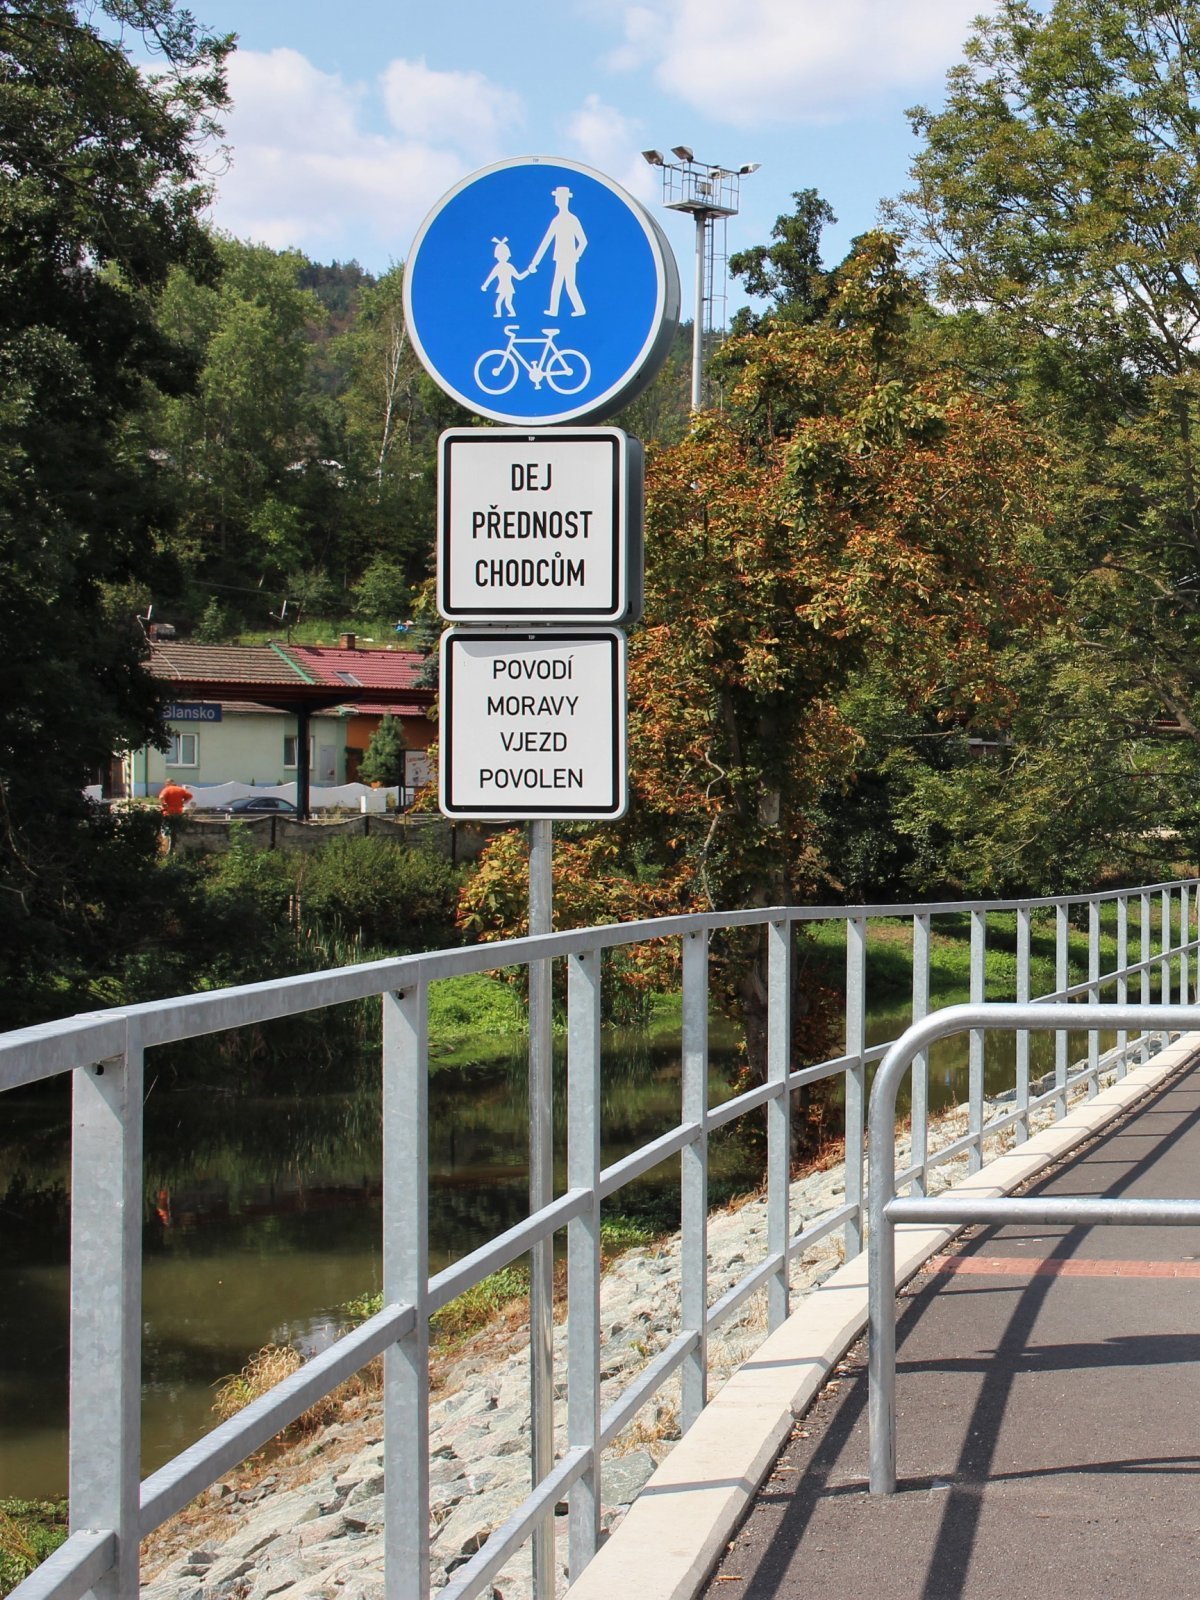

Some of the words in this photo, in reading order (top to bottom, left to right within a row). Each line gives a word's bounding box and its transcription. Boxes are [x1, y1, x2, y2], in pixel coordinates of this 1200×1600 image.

[511, 463, 552, 492] DEJ
[472, 504, 593, 539] PŘEDNOST
[475, 551, 585, 588] CHODCŮM
[493, 655, 574, 680] POVODÍ
[488, 695, 579, 716] MORAVY
[500, 731, 568, 752] VJEZD
[480, 768, 583, 789] POVOLEN
